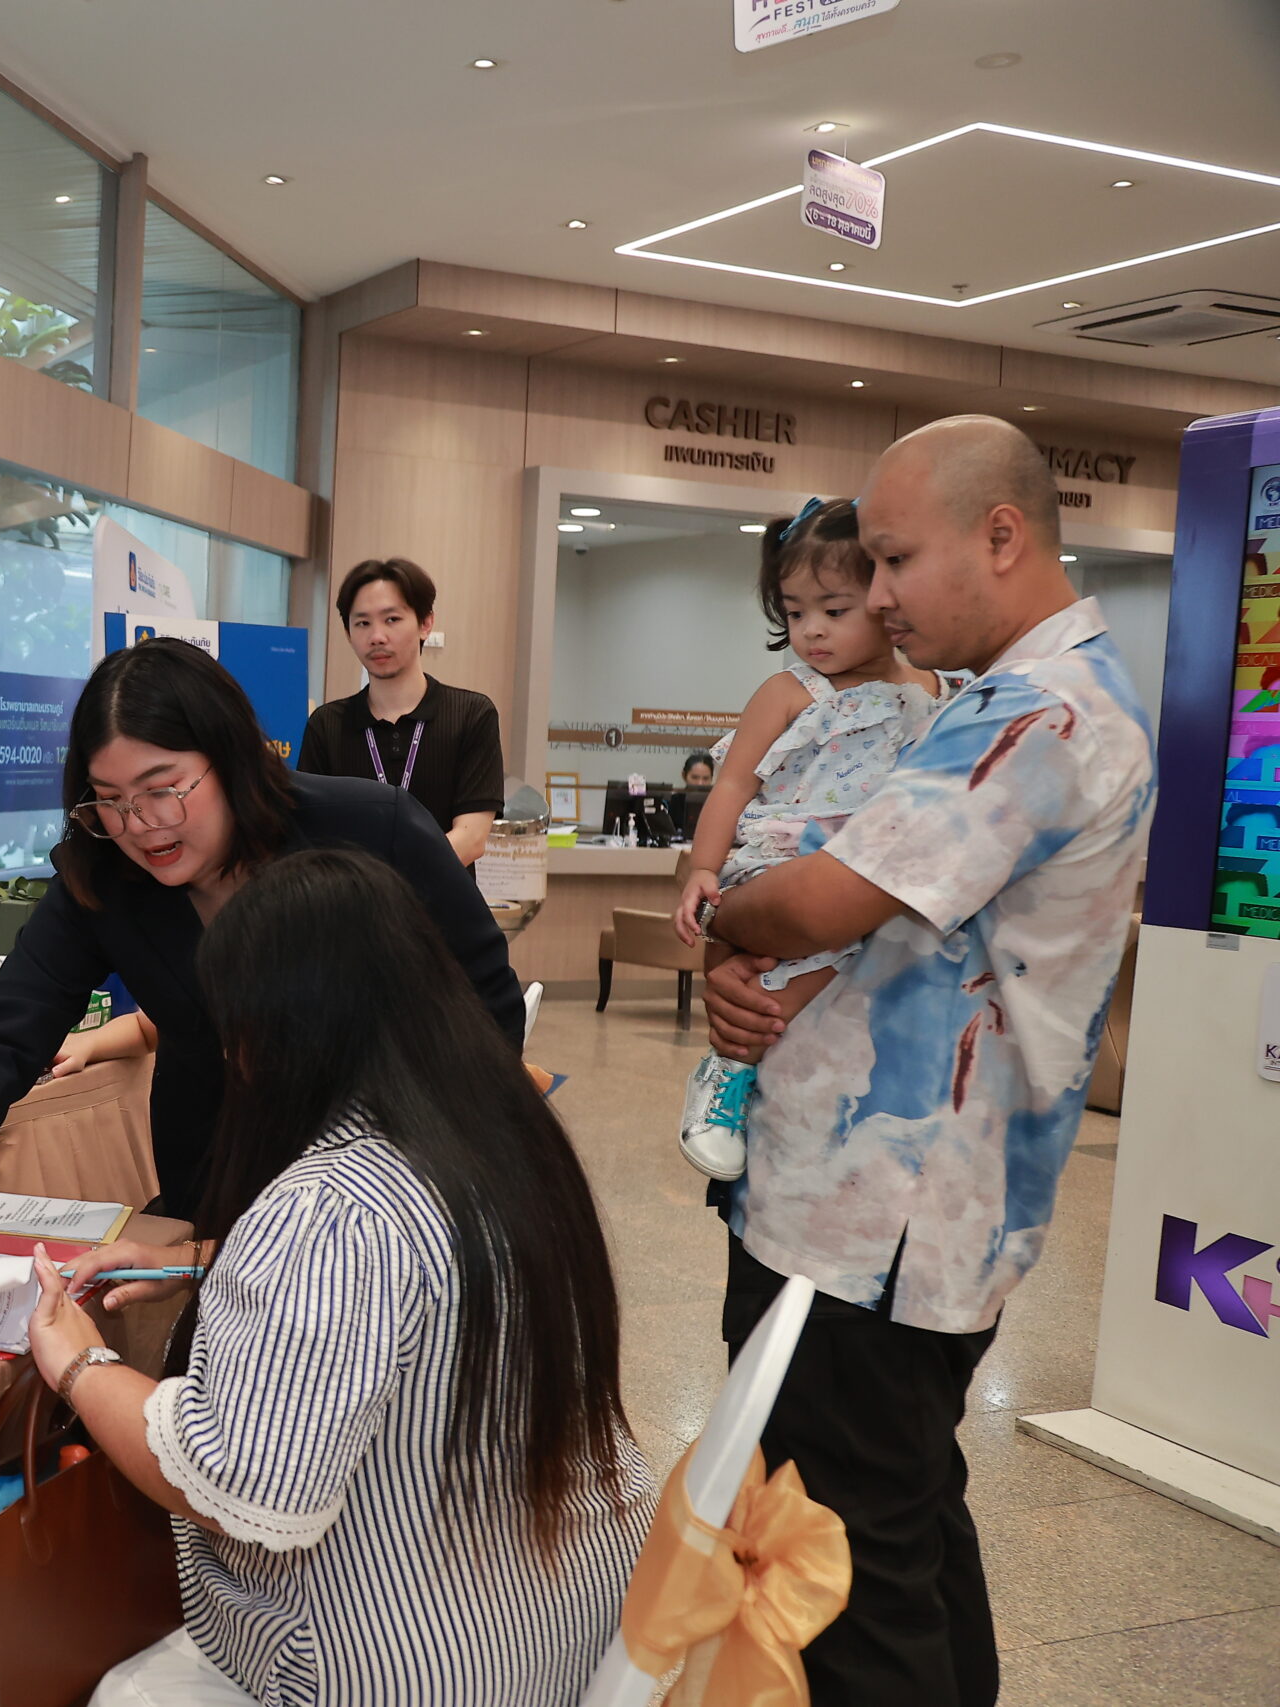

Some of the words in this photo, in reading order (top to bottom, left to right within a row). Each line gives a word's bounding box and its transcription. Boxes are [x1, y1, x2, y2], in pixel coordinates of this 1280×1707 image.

[810, 184, 845, 208] ลดสูงสุด
[846, 188, 878, 219] 70%
[645, 397, 796, 445] CASHIER
[664, 445, 775, 474] แผนกการเงิน
